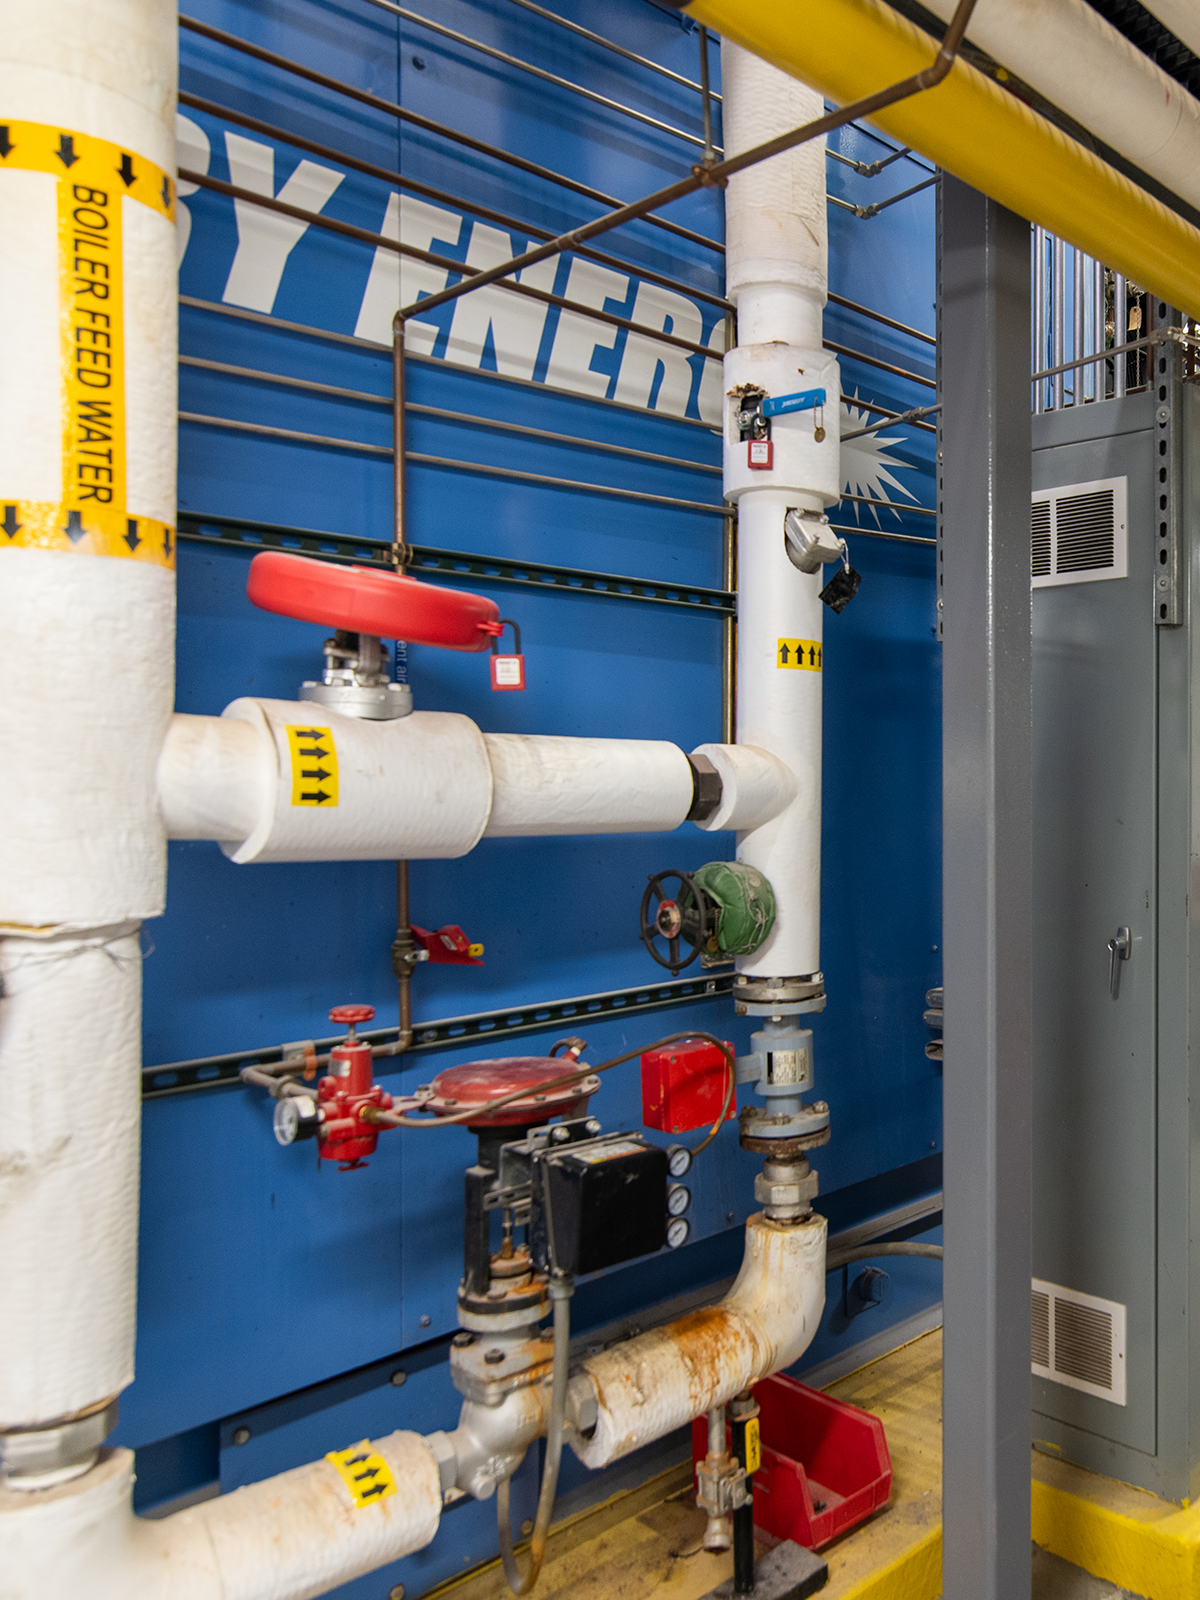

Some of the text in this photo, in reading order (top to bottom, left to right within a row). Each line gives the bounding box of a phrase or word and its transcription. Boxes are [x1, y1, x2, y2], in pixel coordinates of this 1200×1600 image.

[73, 183, 113, 505] BOILER FEED WATER
[354, 192, 727, 436] ENER
